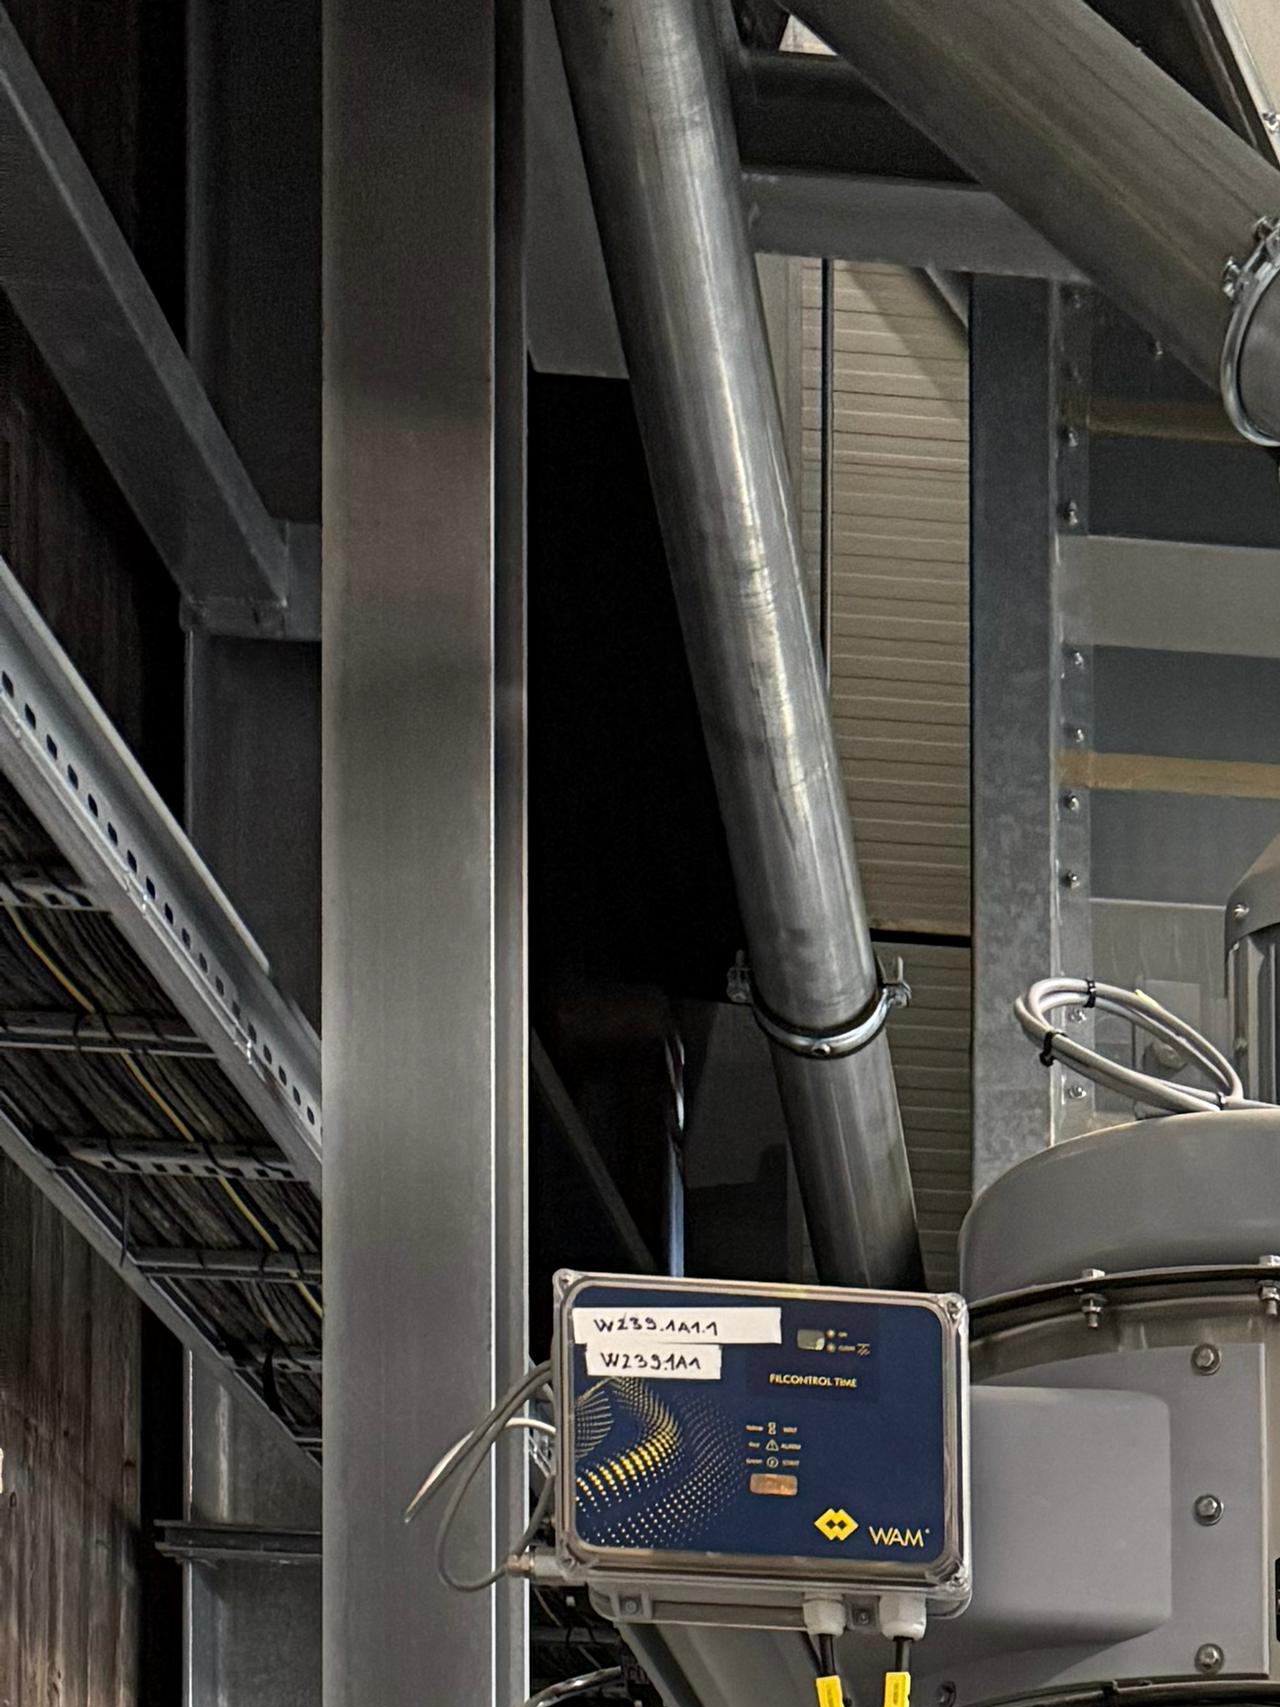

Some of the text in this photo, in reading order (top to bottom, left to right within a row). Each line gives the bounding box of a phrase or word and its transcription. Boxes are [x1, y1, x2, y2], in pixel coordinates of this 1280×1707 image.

[600, 1352, 701, 1371] W239.1A1
[769, 1373, 857, 1388] FILCONTROL TIME
